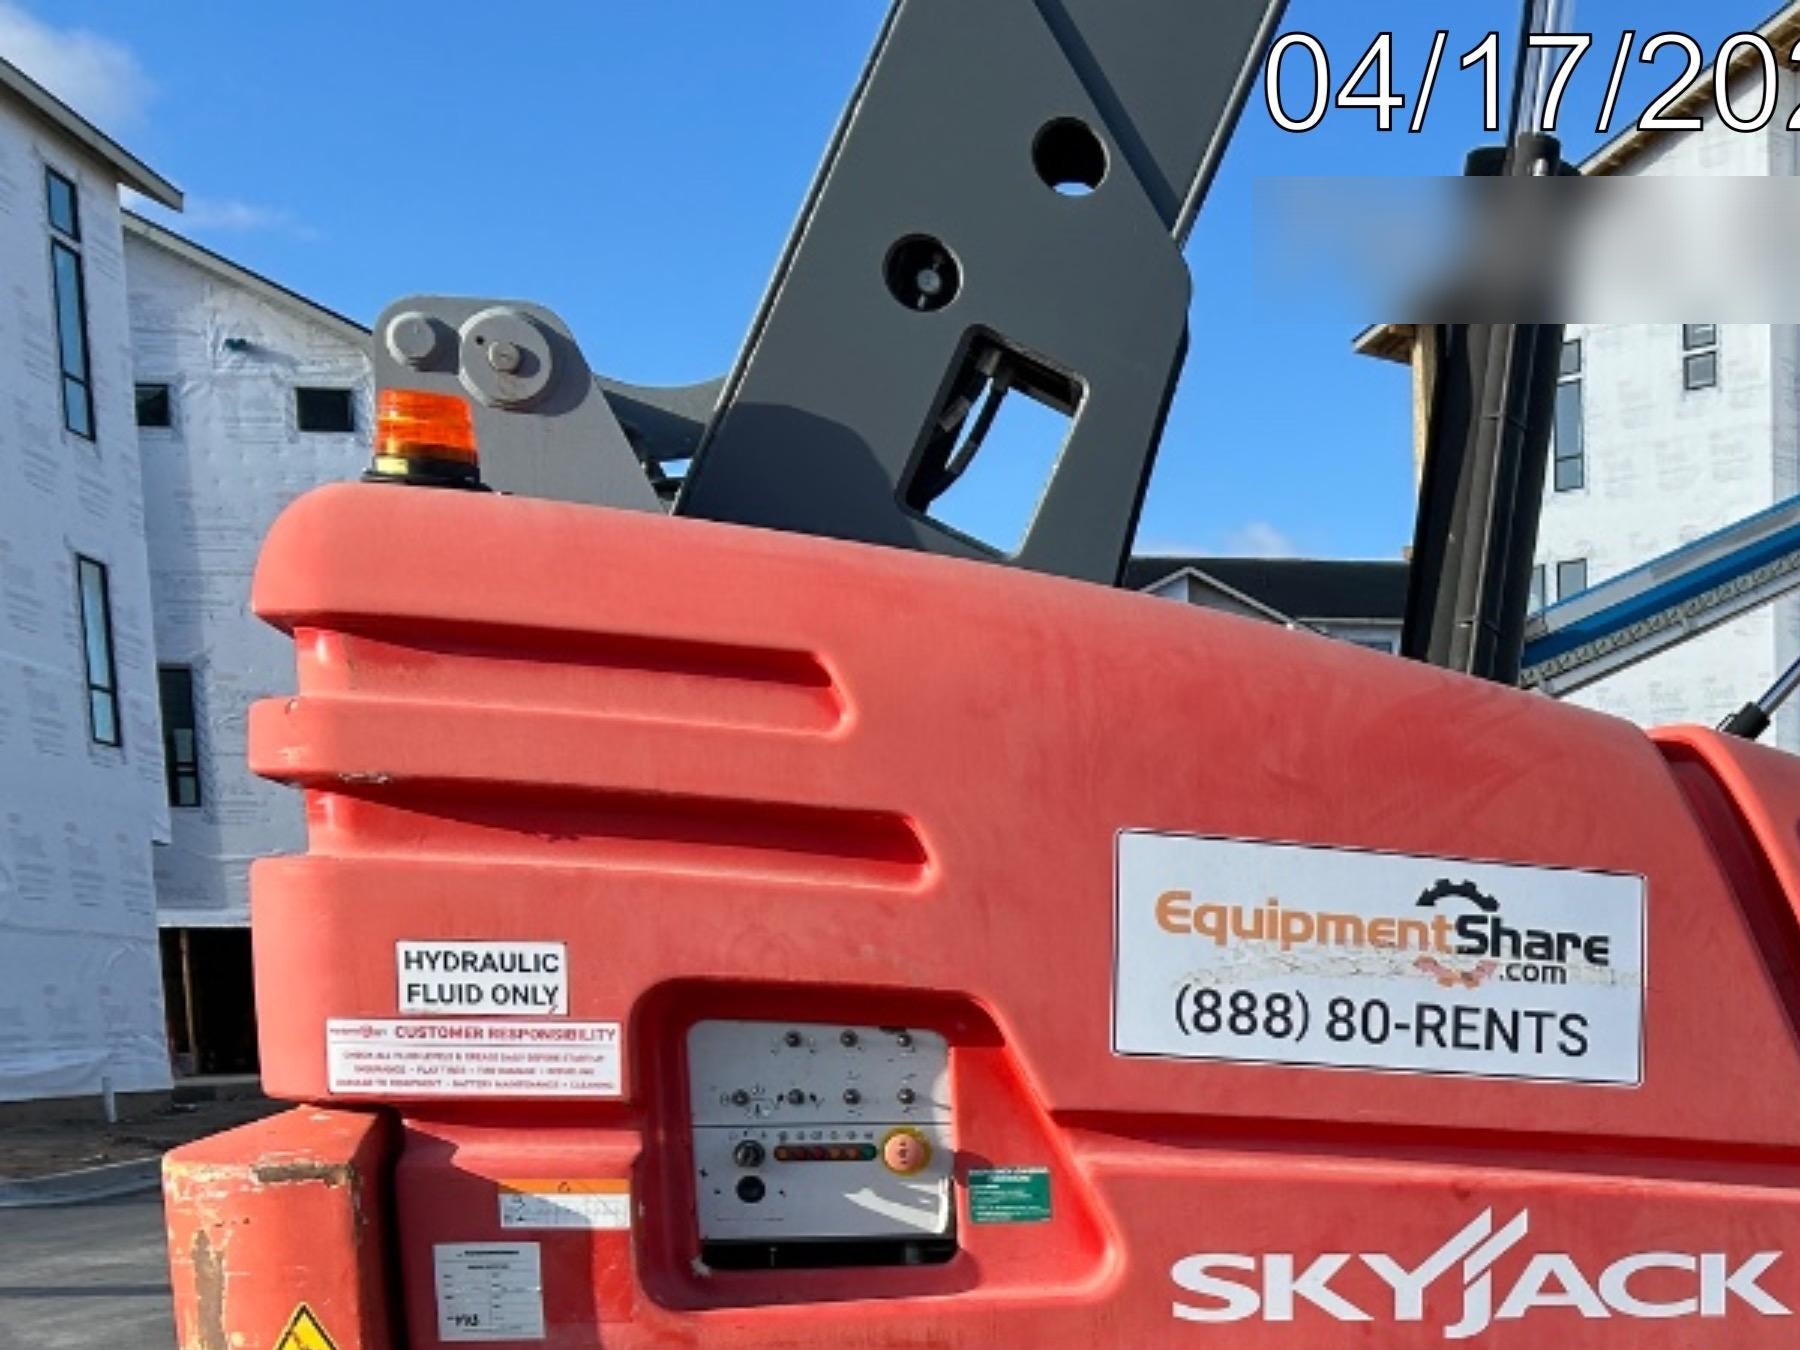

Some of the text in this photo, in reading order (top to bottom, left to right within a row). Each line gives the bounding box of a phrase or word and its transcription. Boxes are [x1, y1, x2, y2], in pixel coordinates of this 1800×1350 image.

[1153, 888, 1611, 968] EquipmentShare
[403, 949, 560, 973] HYDRAULIC
[1498, 958, 1568, 986] .com
[406, 983, 560, 1006] FLUID ONLY
[394, 1025, 484, 1040] CUSTOMER
[487, 1027, 616, 1042] RESPONSIBILITY
[1174, 983, 1590, 1057] (888) 80-RENTS
[1170, 1206, 1794, 1341] SKYJACK
